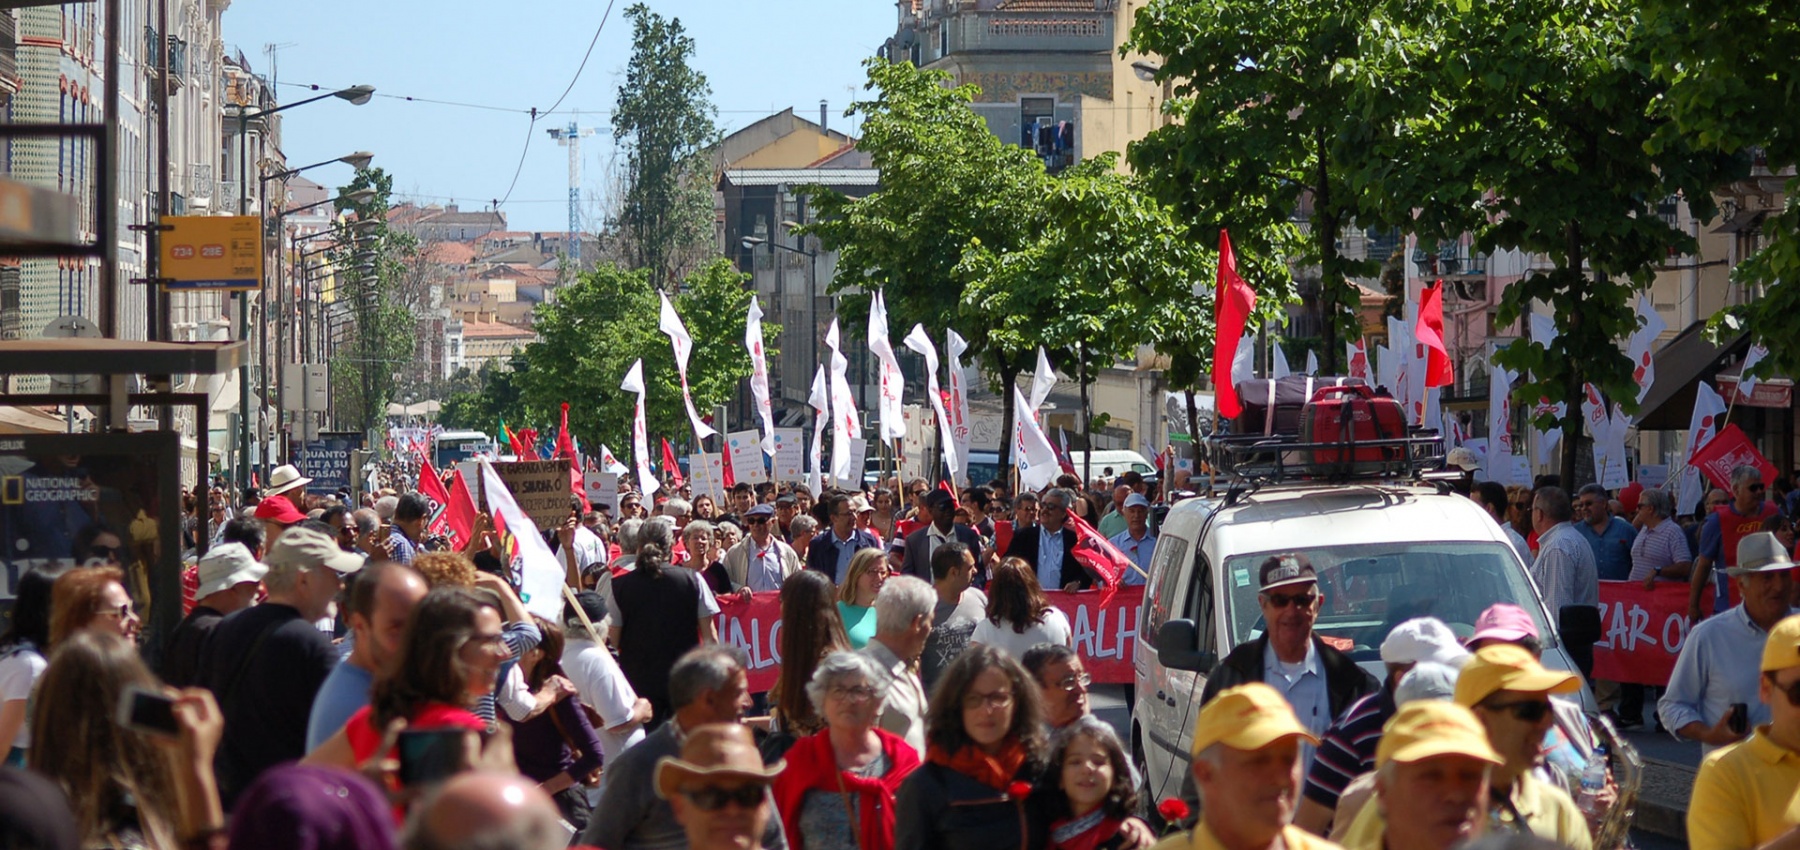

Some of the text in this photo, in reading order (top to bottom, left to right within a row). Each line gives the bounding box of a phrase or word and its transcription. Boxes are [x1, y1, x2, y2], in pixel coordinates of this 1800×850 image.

[173, 247, 194, 257] 734
[304, 450, 347, 459] QUANTO
[323, 460, 331, 468] A
[334, 460, 348, 468] SU
[308, 469, 341, 478] CASA?
[25, 477, 81, 489] NATIONAL
[24, 489, 98, 502] GEOGRAPHIC
[1065, 604, 1142, 664] ALH
